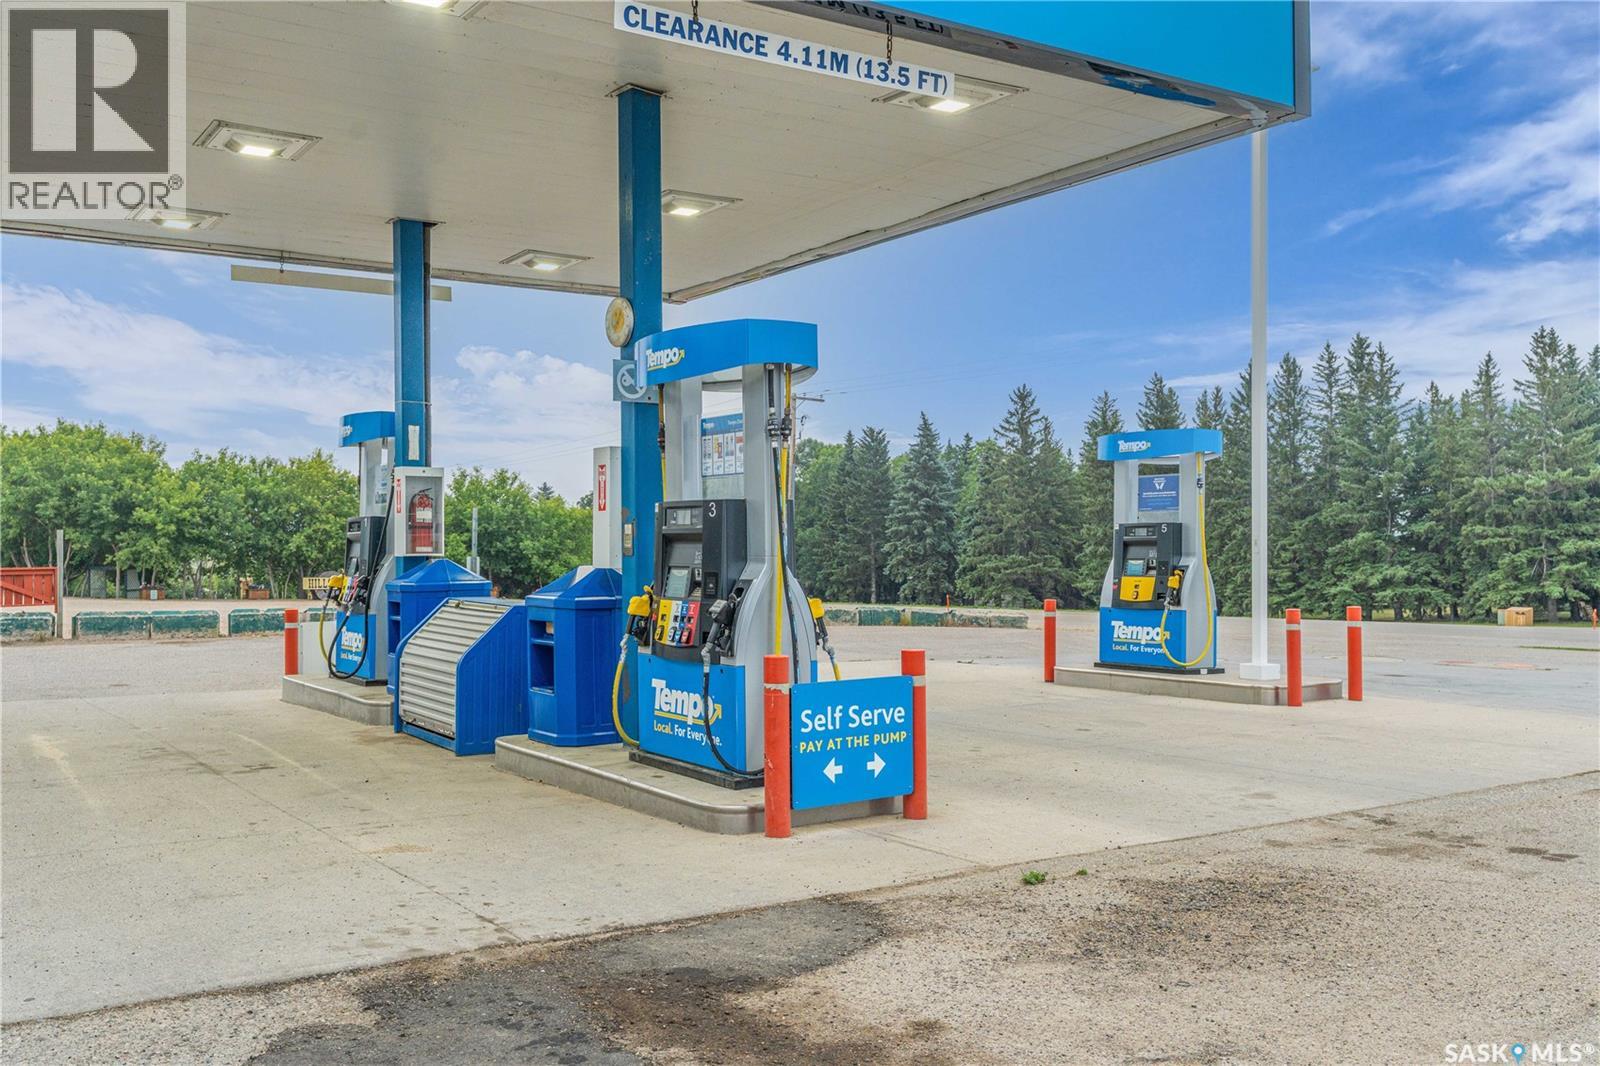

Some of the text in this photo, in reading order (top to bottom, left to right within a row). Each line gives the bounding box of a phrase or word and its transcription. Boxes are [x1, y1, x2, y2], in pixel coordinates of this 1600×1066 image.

[623, 5, 949, 96] CLEARANCE 4.11M (13.5 FT)
[645, 347, 679, 369] Tempo
[1118, 440, 1146, 452] Tempo
[708, 502, 717, 518] 3
[1161, 524, 1168, 533] 5
[1111, 620, 1162, 645] Tempo
[651, 678, 714, 725] Tempo
[653, 719, 673, 735] Local.
[674, 724, 686, 738] For
[801, 704, 906, 733] Self Serve
[800, 731, 907, 754] PAY AT THE PUMP
